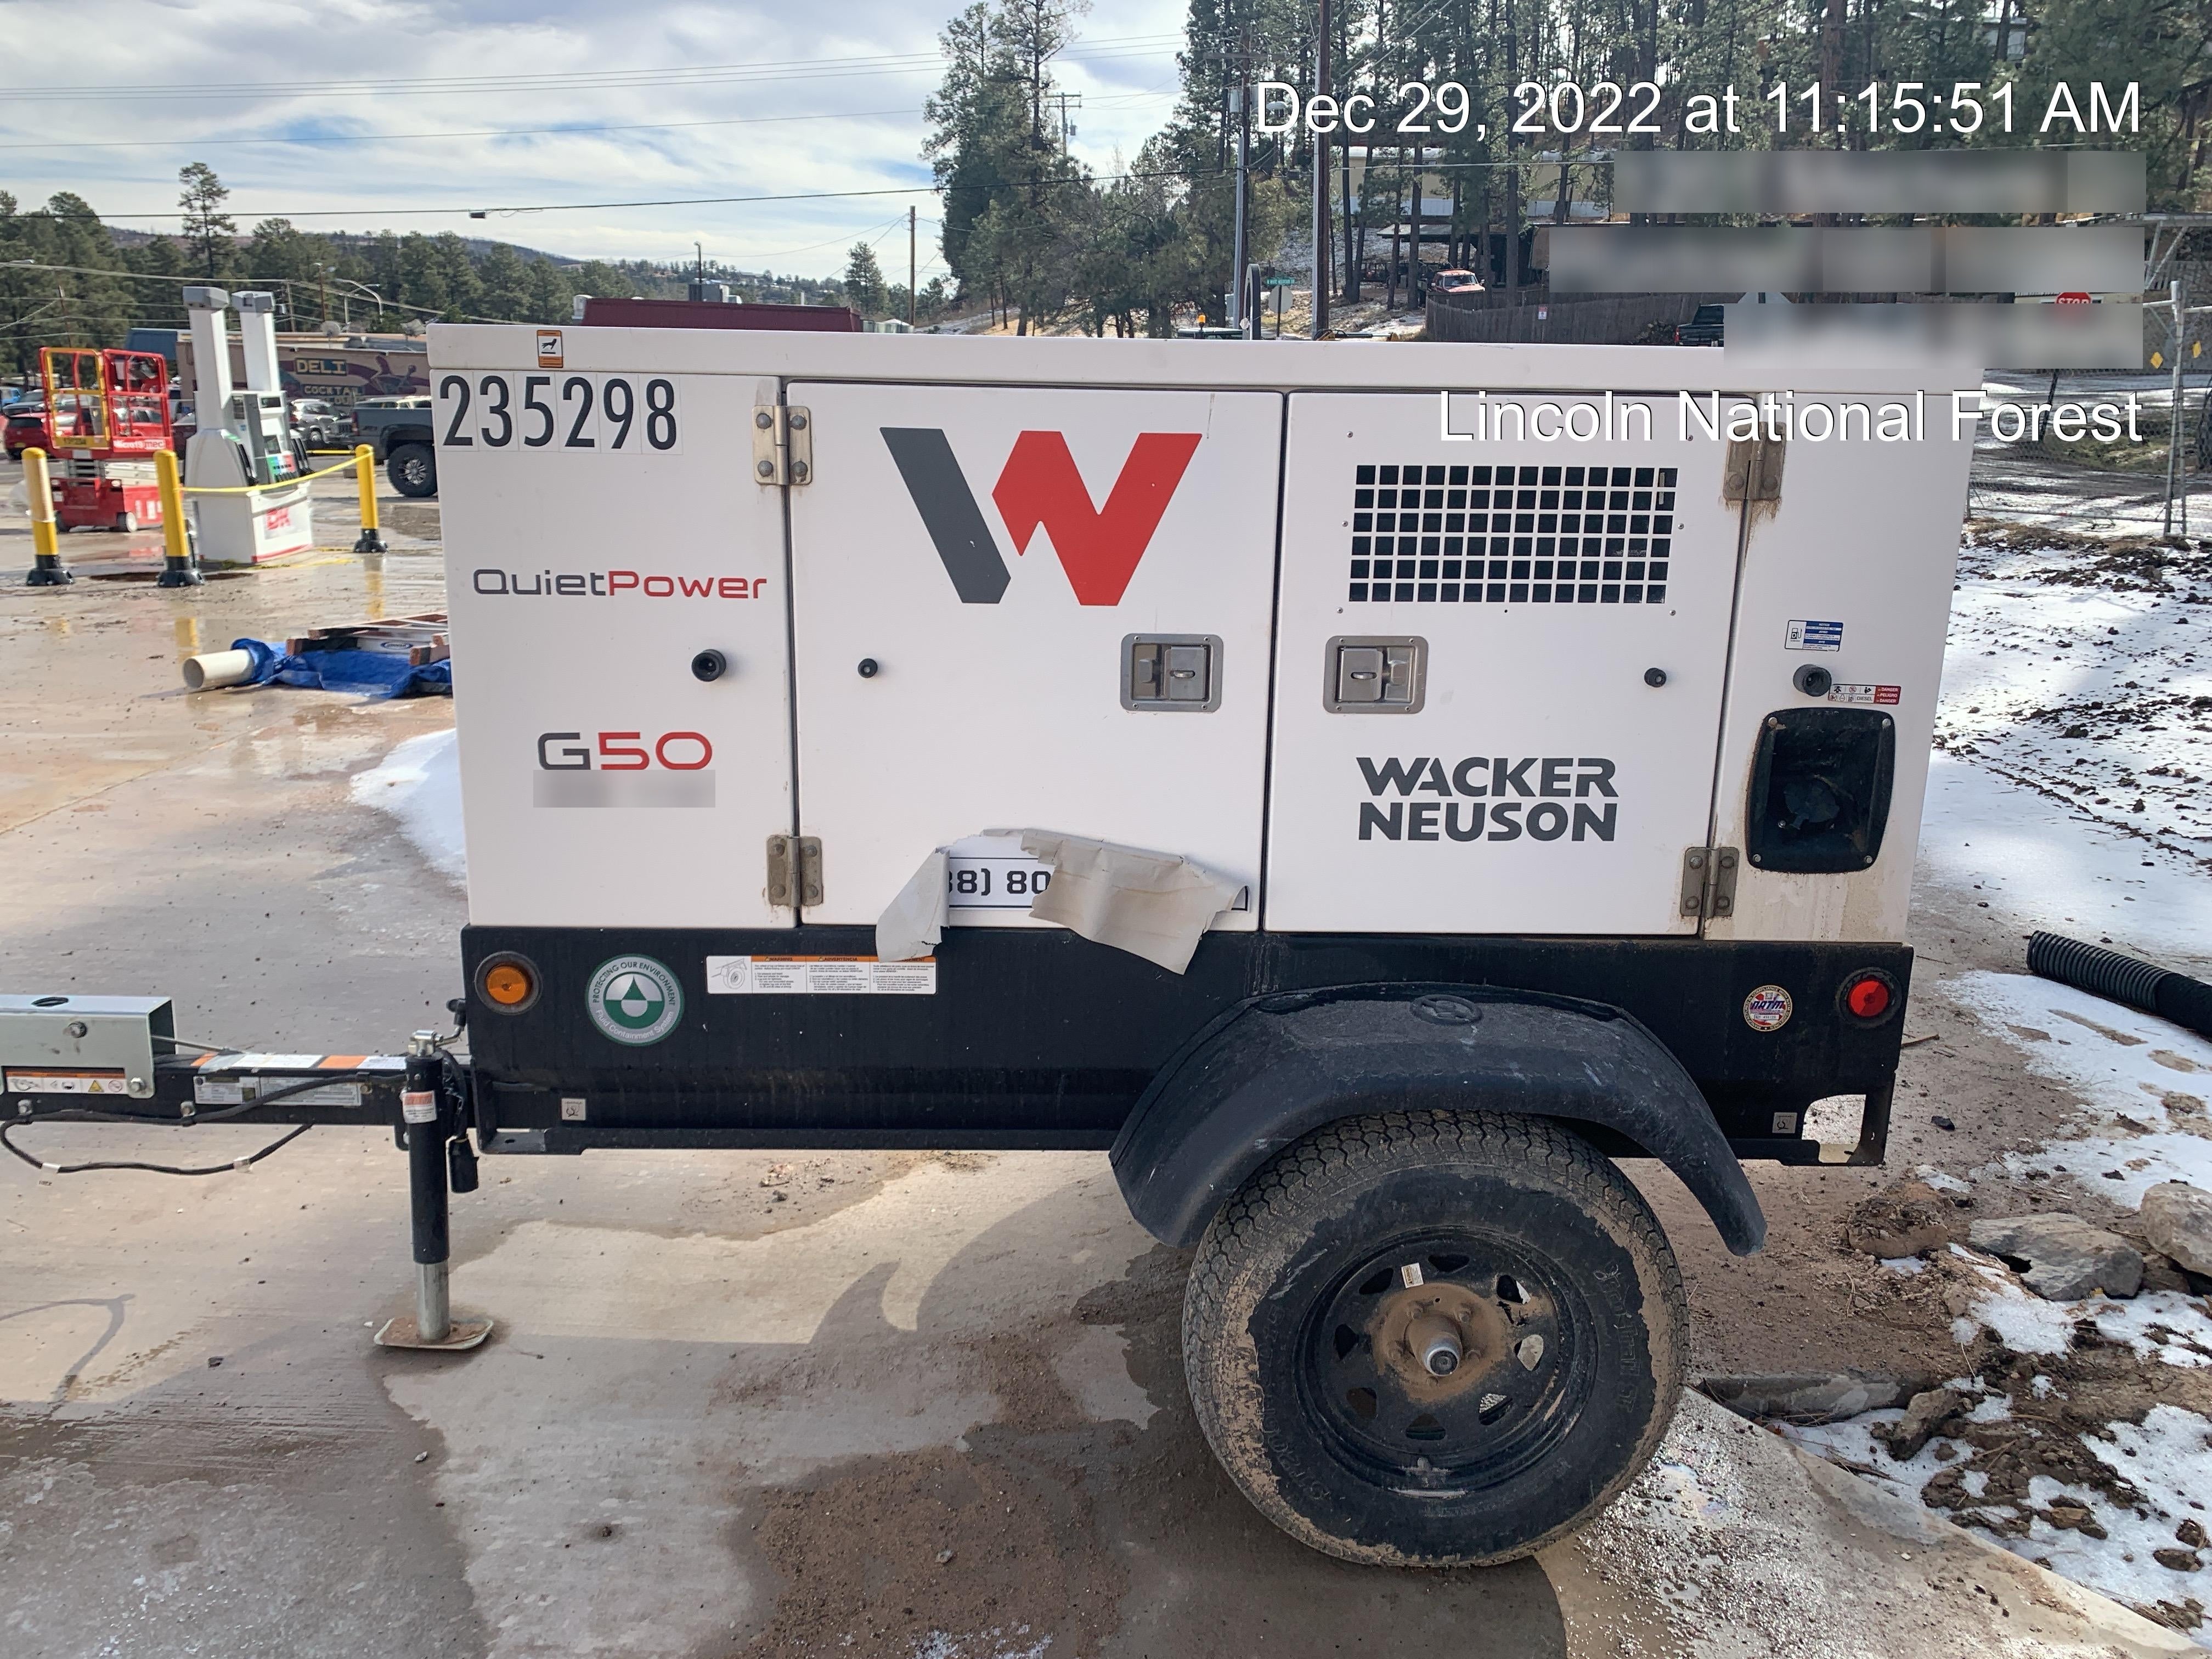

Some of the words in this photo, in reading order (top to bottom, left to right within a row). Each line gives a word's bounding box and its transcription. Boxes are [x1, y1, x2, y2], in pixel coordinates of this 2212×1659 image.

[296, 359, 346, 374] DELI
[304, 385, 362, 396] COCKTAIL
[439, 375, 678, 450] 235298
[473, 568, 767, 599] QuietPower
[538, 731, 713, 770] G50
[1356, 757, 1619, 797] WACKER
[1358, 802, 1617, 842] NEUSON
[949, 868, 990, 896] 8)
[593, 965, 619, 1003] PROTECTING
[620, 961, 637, 969] OUR
[639, 962, 676, 1006] ENVIRONMENT
[595, 1009, 611, 1028] Fluid
[609, 1024, 654, 1040] Containment
[653, 1011, 674, 1034] System
